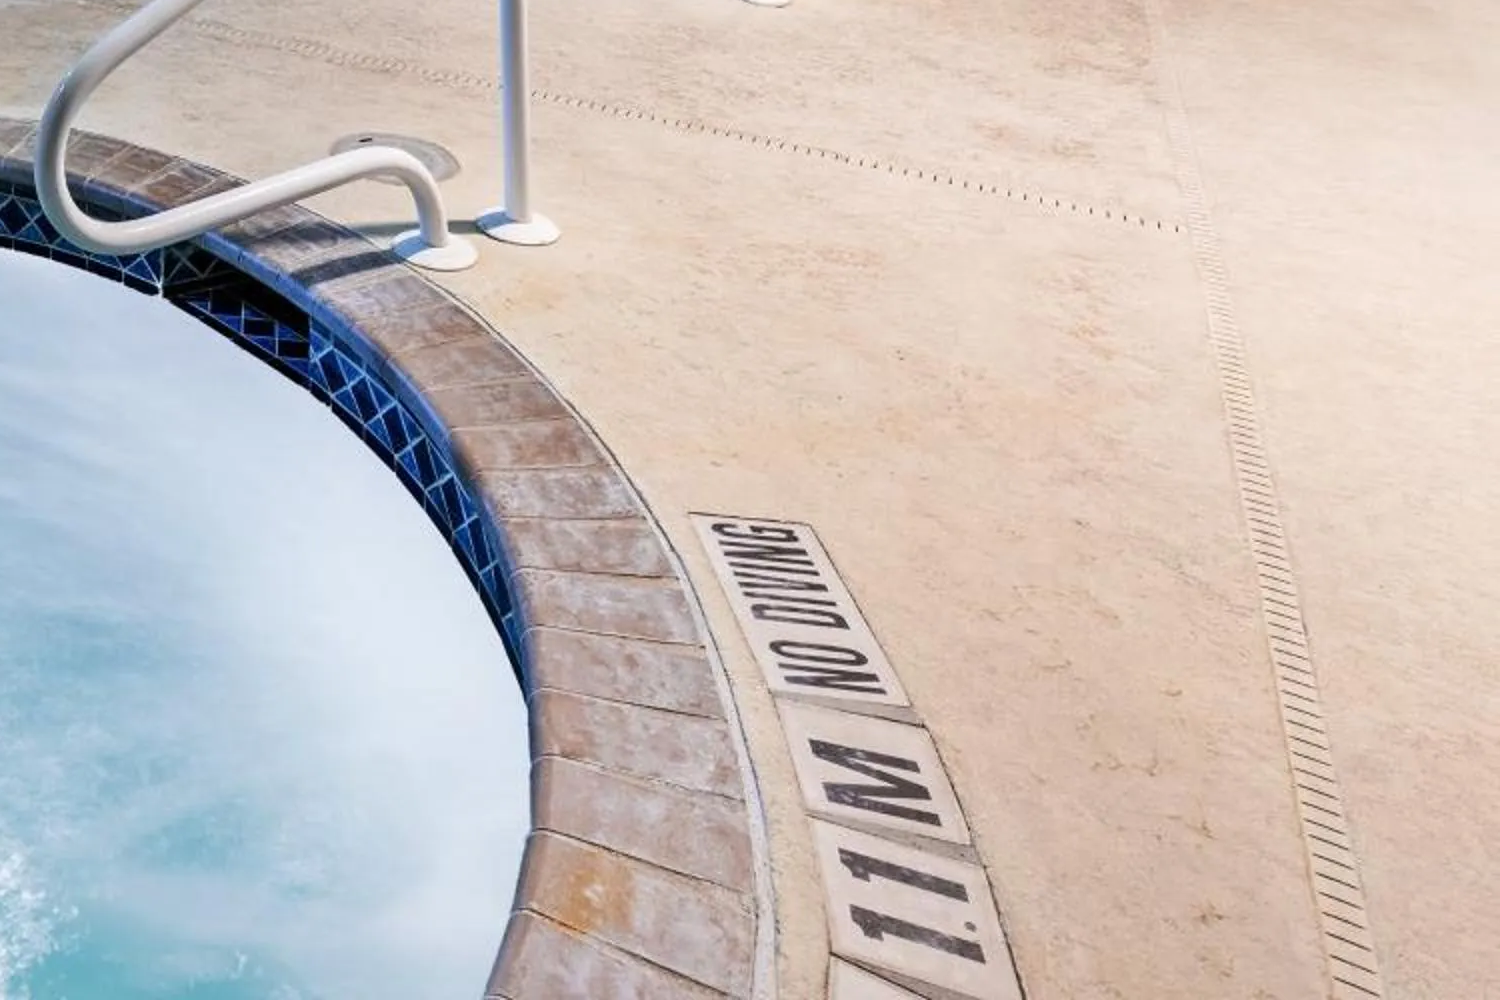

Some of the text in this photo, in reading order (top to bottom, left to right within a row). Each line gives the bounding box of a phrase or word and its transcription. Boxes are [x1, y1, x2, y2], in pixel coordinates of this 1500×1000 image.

[711, 522, 987, 965] 1.1 M NO DIVING
